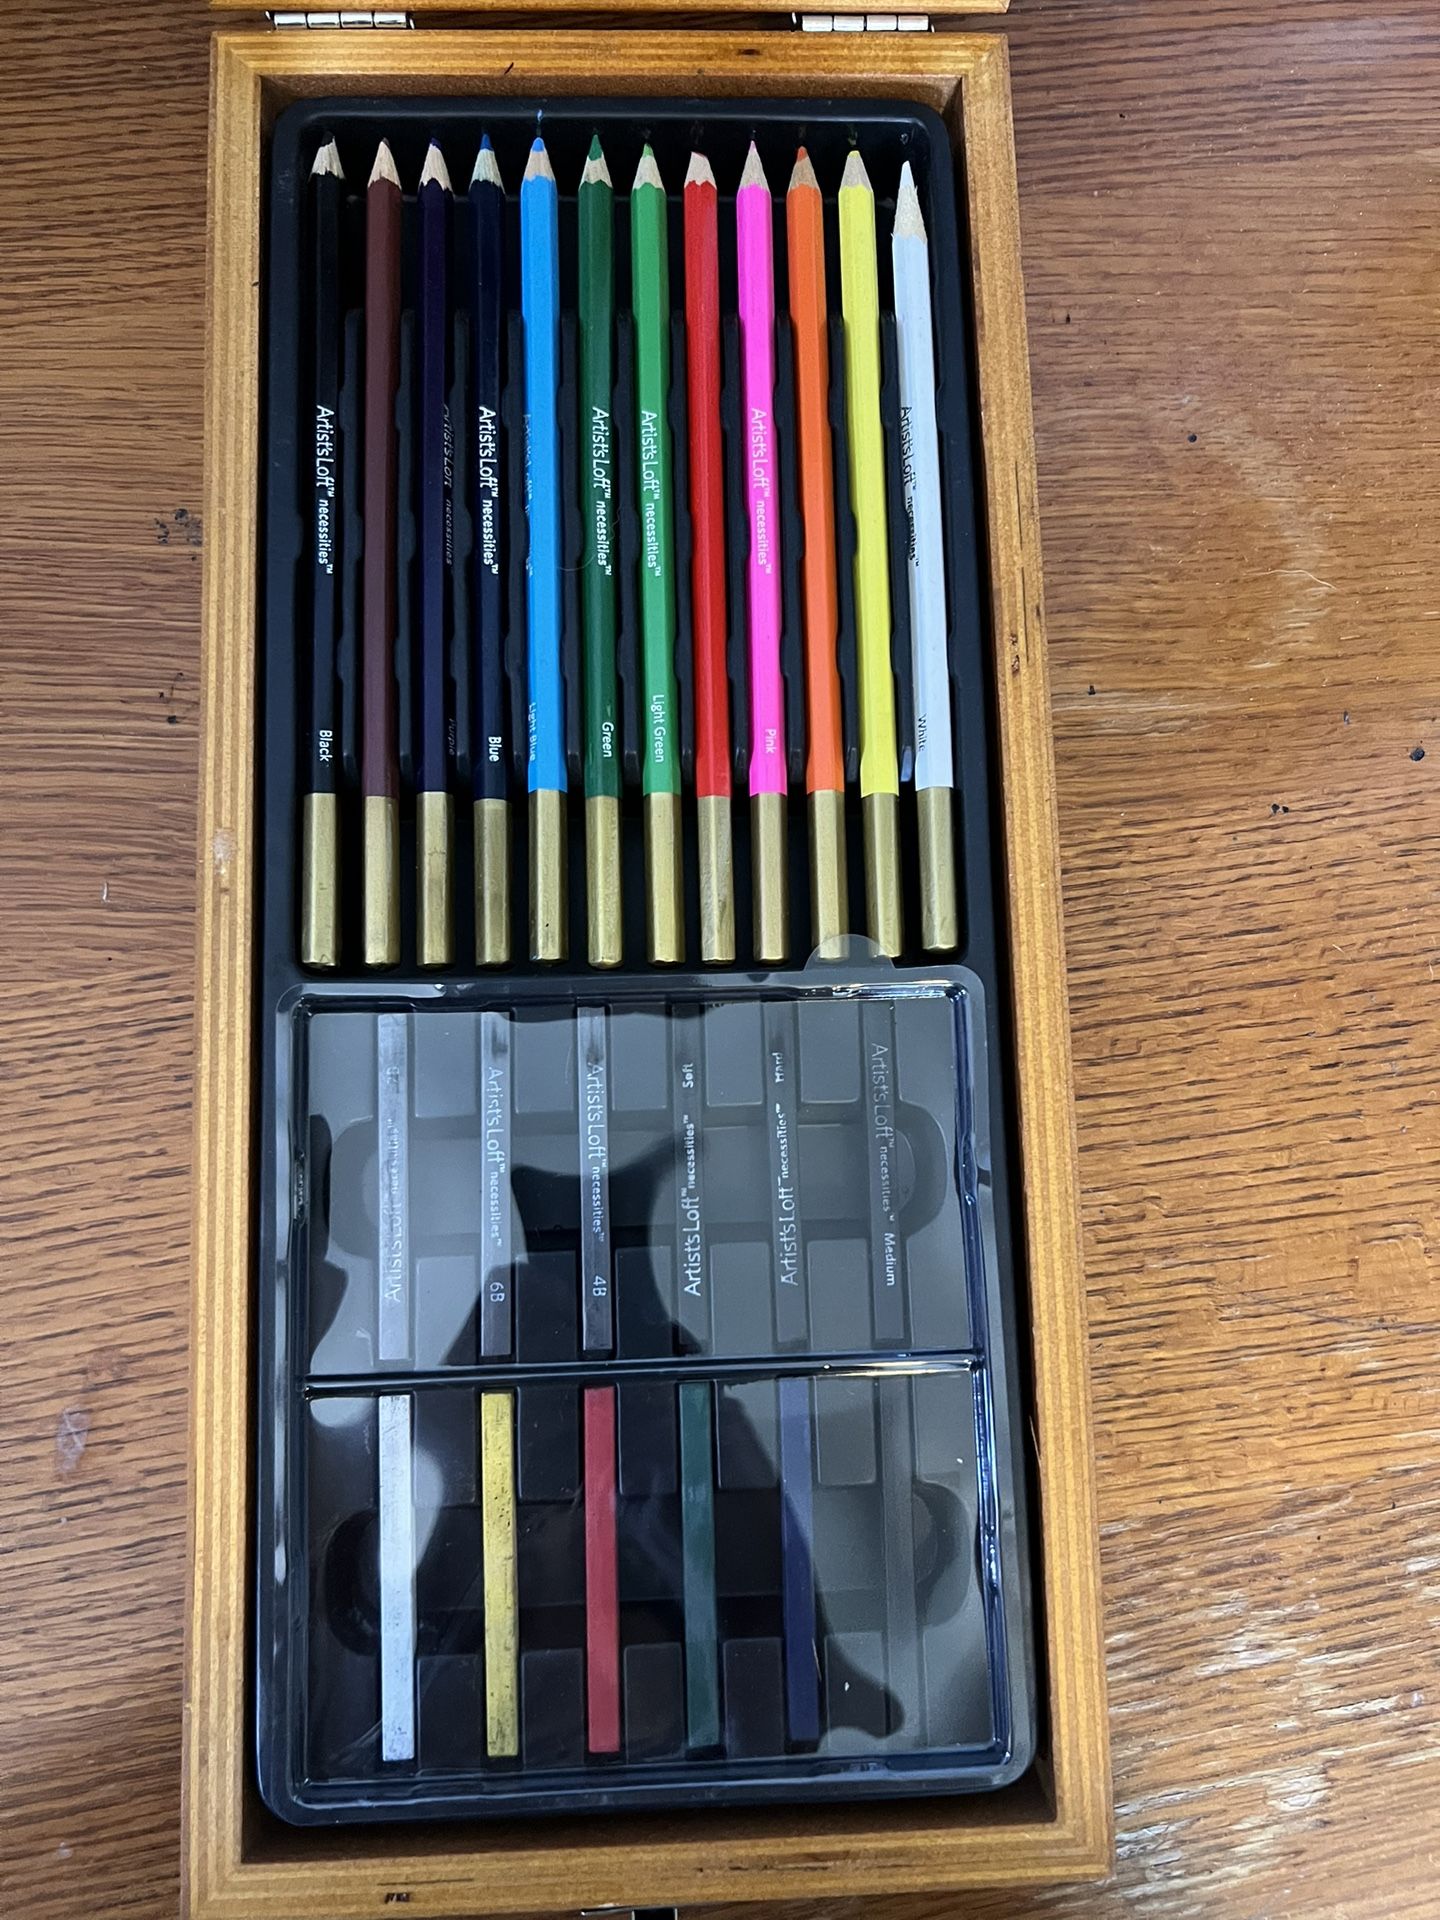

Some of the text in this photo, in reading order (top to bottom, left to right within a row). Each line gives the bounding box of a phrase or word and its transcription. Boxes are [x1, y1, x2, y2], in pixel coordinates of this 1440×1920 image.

[316, 405, 335, 456] Artist's
[479, 406, 496, 457] Artist's
[592, 406, 610, 458] Artist's
[641, 410, 658, 461] Artist's
[751, 407, 767, 458] Artist's
[319, 729, 333, 762] Black
[488, 736, 502, 762] Blue
[601, 721, 615, 758] Green
[650, 694, 667, 763] Light Green
[765, 728, 777, 754] Pink
[917, 713, 927, 752] White
[682, 1063, 694, 1088] Soft
[682, 1233, 701, 1296] Artist's
[884, 1232, 896, 1286] Medium
[490, 1282, 505, 1302] 6B
[593, 1275, 607, 1297] 4B
